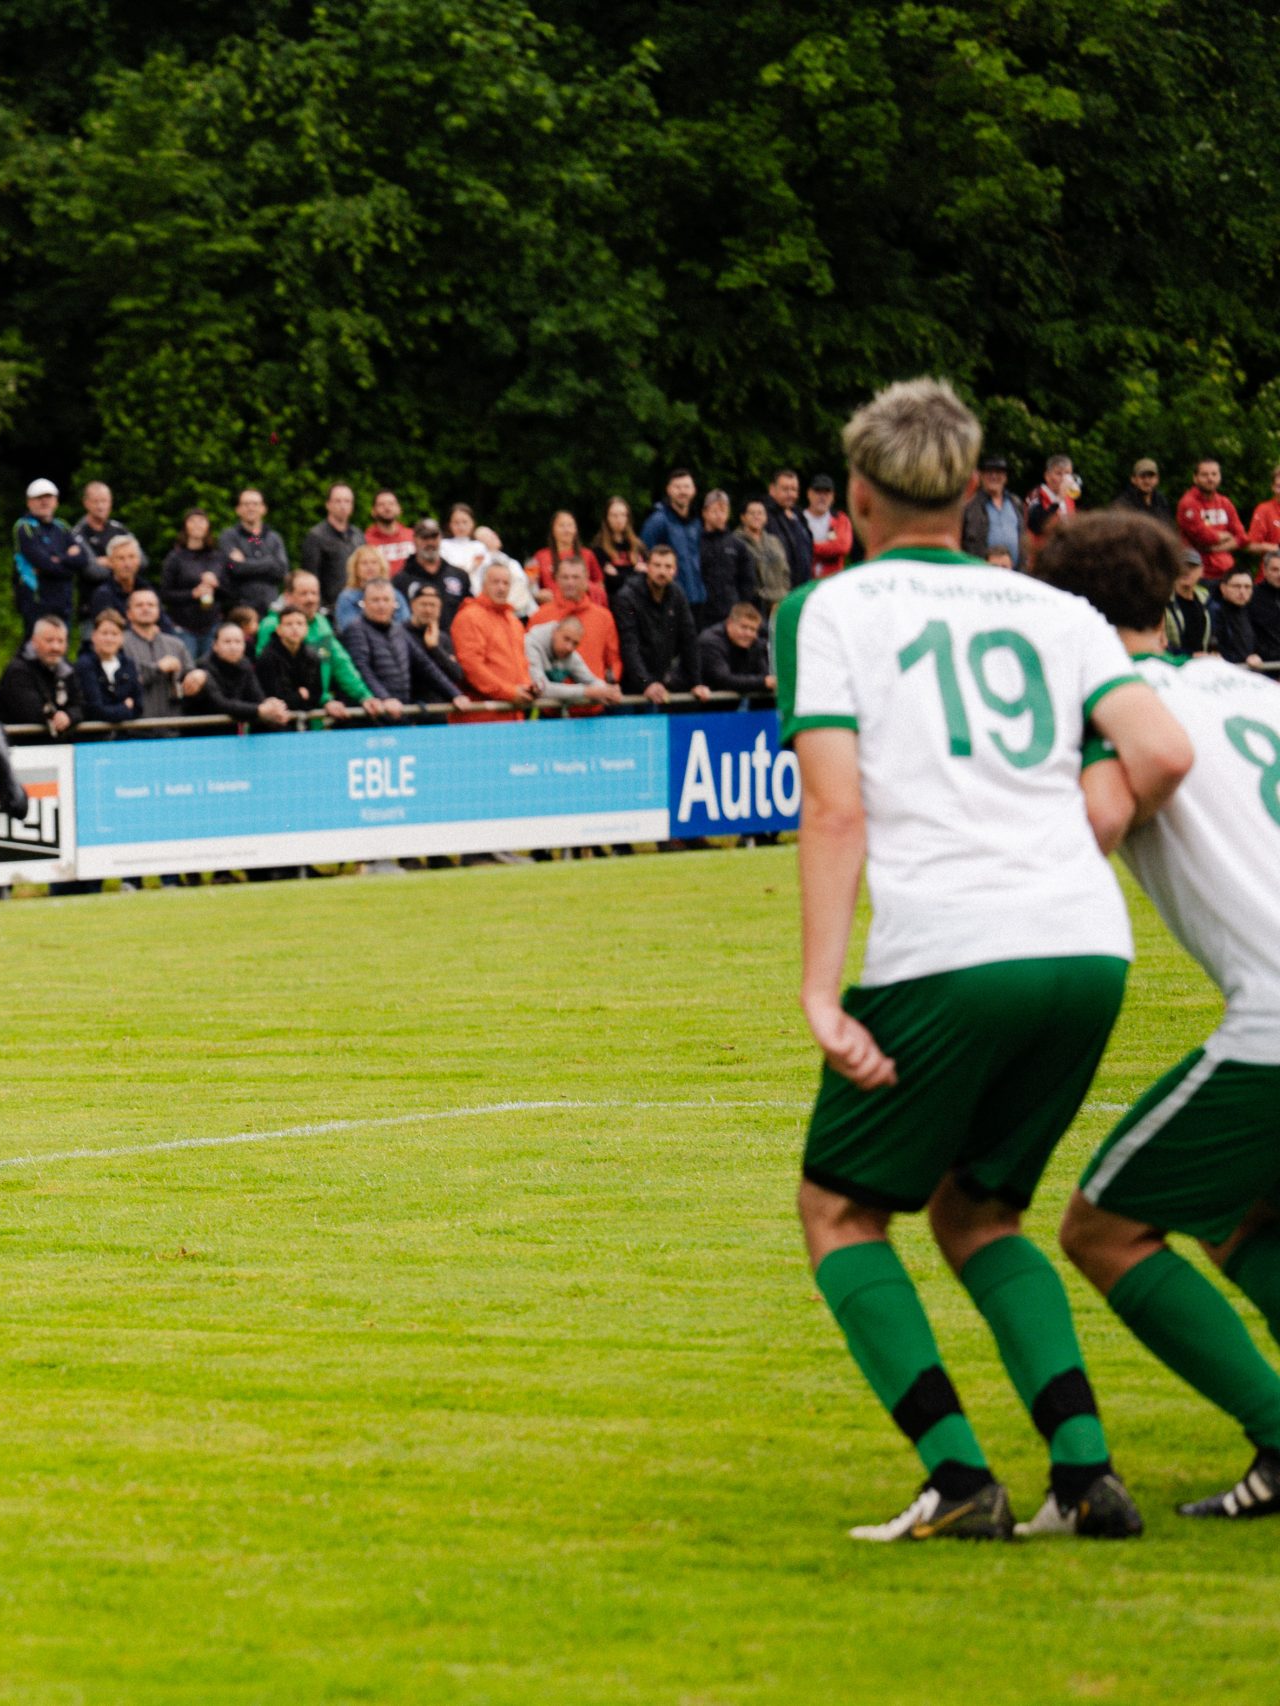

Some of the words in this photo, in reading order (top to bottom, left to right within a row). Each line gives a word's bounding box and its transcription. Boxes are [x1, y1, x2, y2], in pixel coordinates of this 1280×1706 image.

[897, 619, 1055, 769] 19
[348, 755, 417, 800] EBLE
[677, 729, 801, 822] Auto
